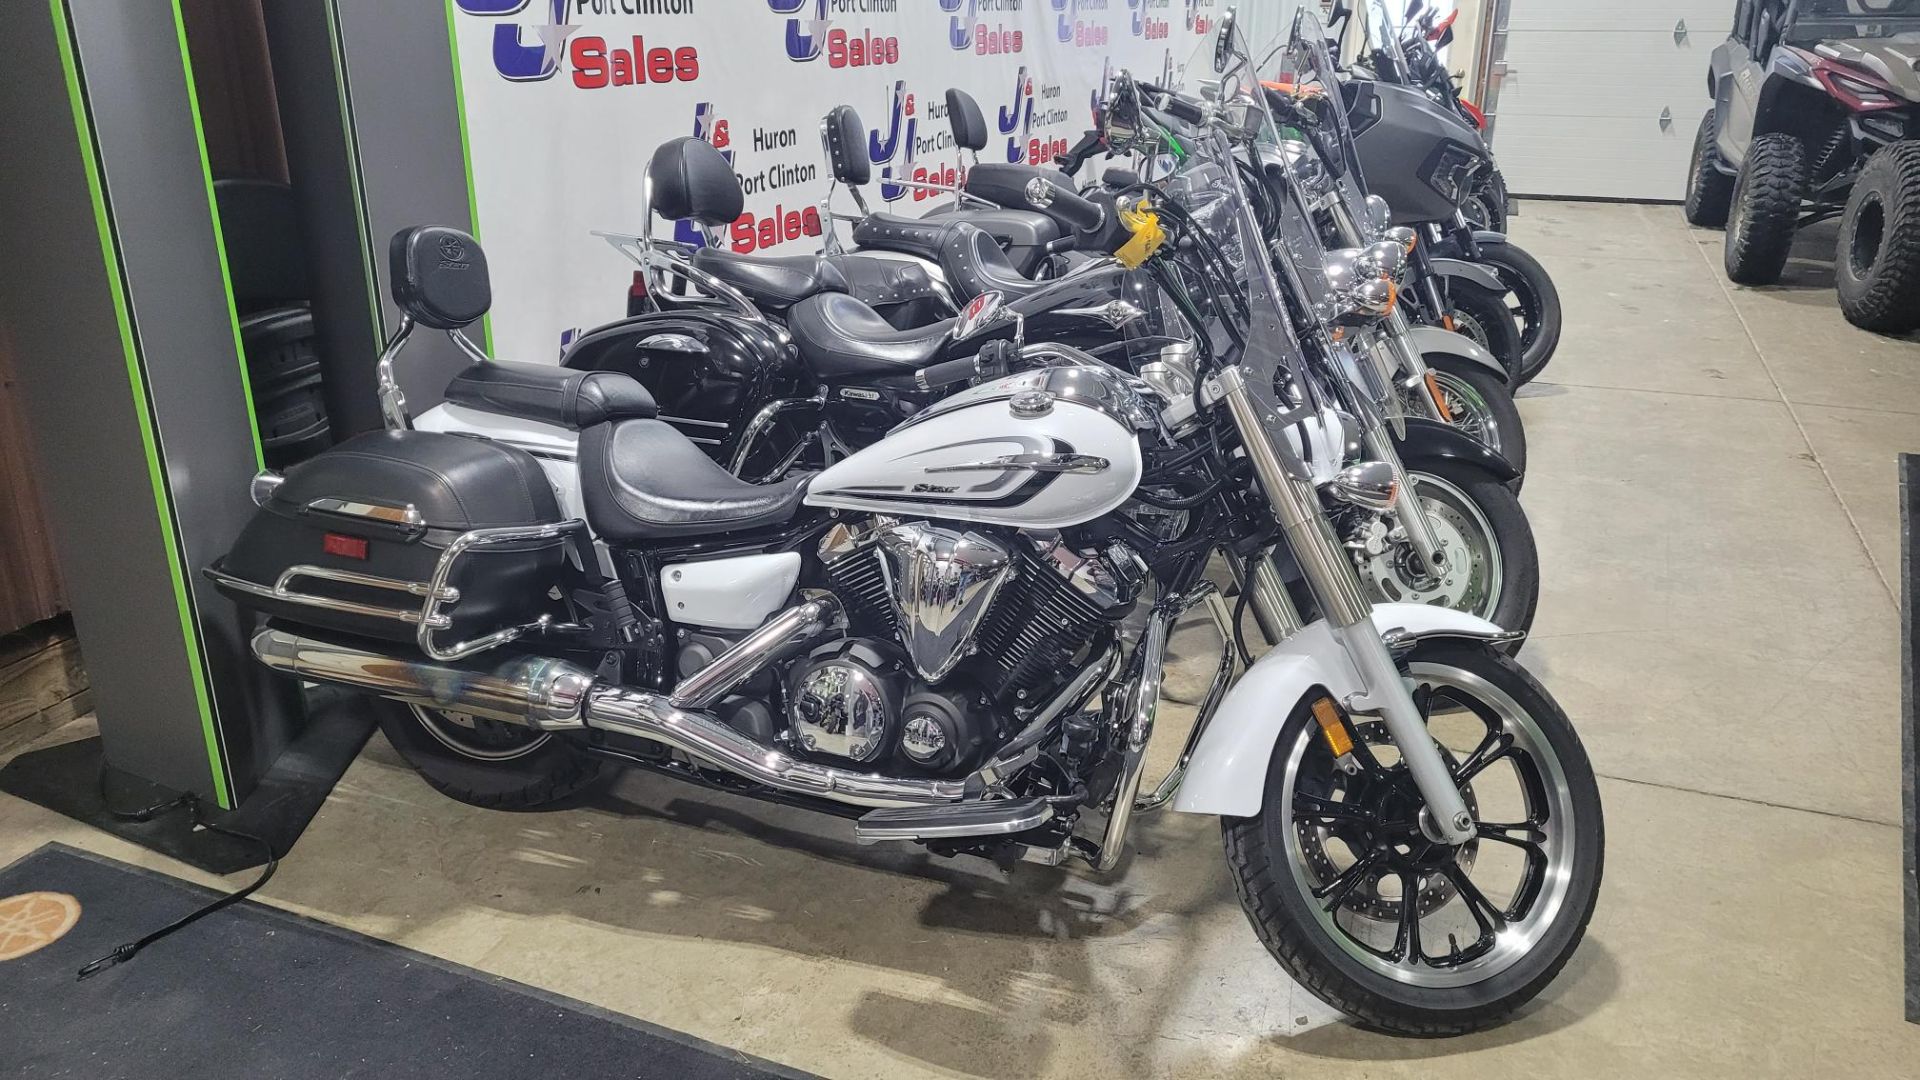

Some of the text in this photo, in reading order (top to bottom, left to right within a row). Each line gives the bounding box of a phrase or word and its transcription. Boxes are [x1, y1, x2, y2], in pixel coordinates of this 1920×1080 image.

[827, 27, 899, 69] Sales
[975, 23, 1023, 56] Sales
[570, 35, 699, 89] Sales
[1041, 84, 1061, 100] Huron
[927, 100, 948, 121] Huro
[1032, 108, 1069, 129] Port Clinton
[753, 127, 796, 152] Huron
[916, 130, 956, 155] Port Clin
[1028, 134, 1068, 166] Sales
[768, 163, 816, 189] Clinton
